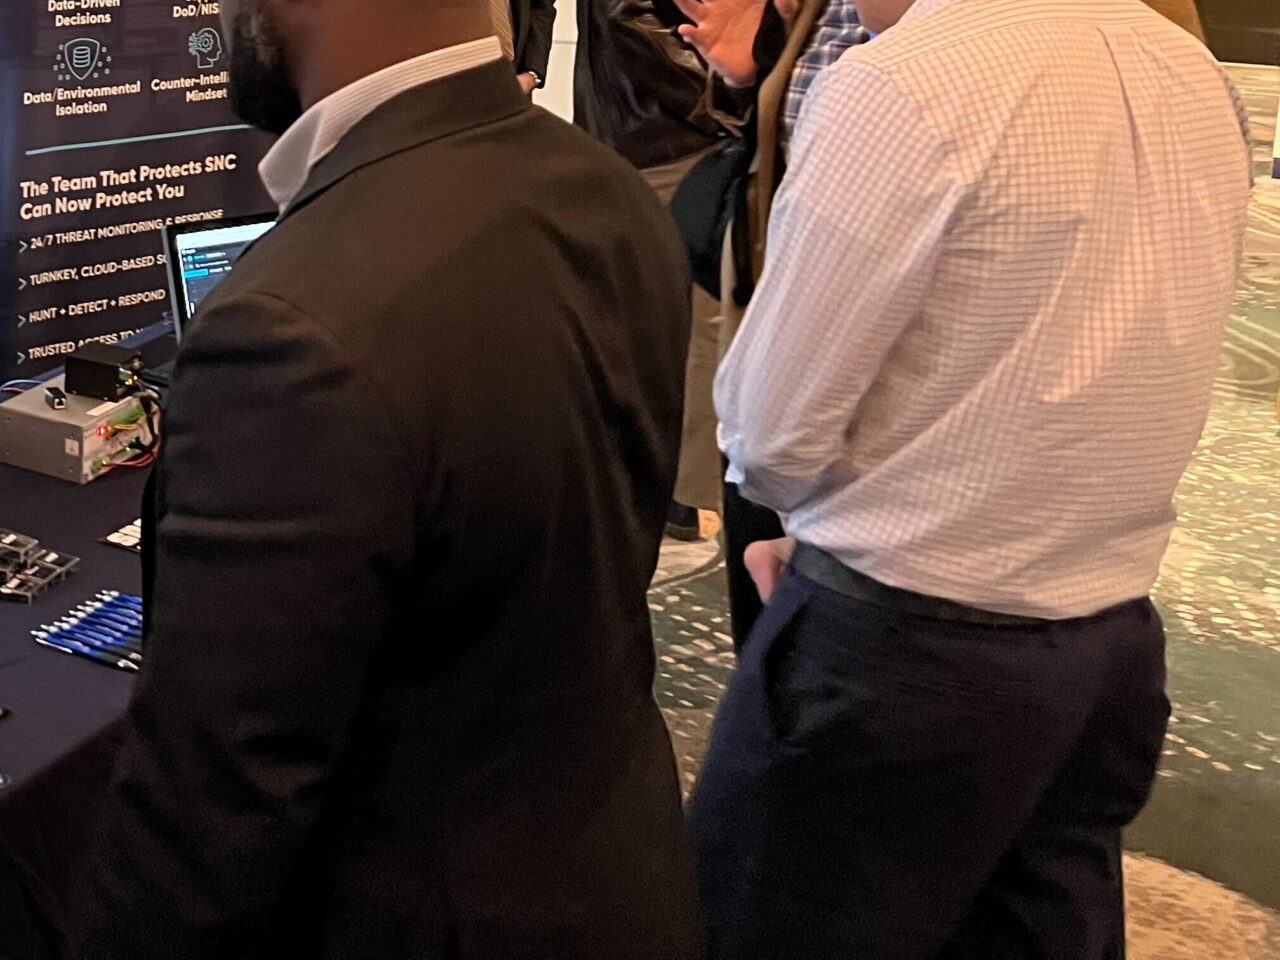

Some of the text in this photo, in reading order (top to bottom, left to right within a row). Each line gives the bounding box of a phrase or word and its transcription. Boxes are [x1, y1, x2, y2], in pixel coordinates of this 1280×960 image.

[55, 13, 111, 27] Decisions
[23, 80, 141, 105] Data/Environmental
[186, 88, 227, 102] Mindset
[55, 102, 107, 117] Isolation
[20, 154, 237, 198] The Team That Protects SNC
[20, 183, 185, 220] Can Now Protect You
[30, 234, 53, 249] 24/7
[55, 228, 96, 244] THREAT
[97, 218, 164, 239] MONITORING
[29, 267, 78, 286] TURNKEY,
[81, 254, 155, 277] CLOUD-BASED
[29, 289, 166, 323] HUNT DETECT RESPOND
[28, 341, 75, 359] TRUSTED
